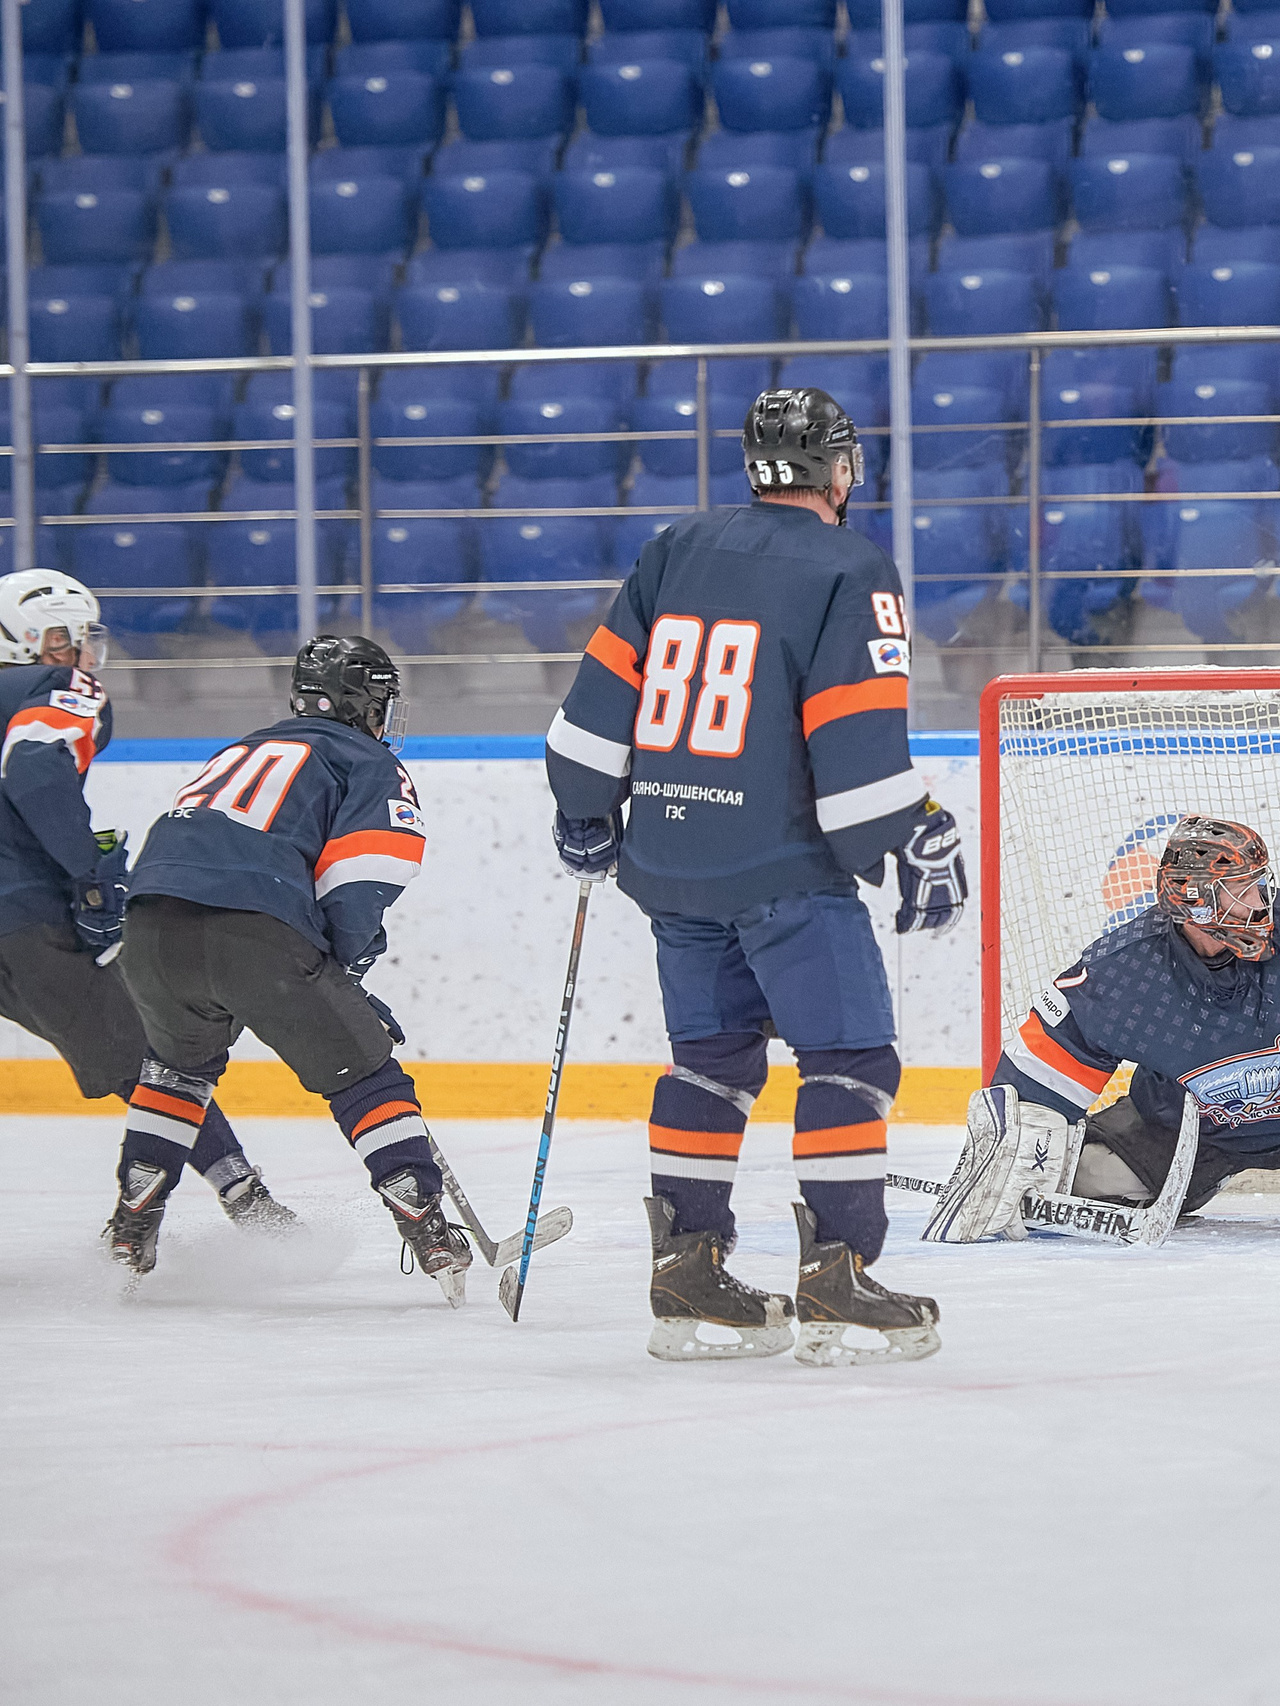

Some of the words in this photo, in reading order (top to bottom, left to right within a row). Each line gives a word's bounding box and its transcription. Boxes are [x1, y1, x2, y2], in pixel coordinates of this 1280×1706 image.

[634, 613, 761, 759] 88
[173, 739, 312, 833] 20
[665, 805, 687, 820] ГЭС
[921, 827, 960, 856] BA
[1023, 1195, 1134, 1238] VAUGHN
